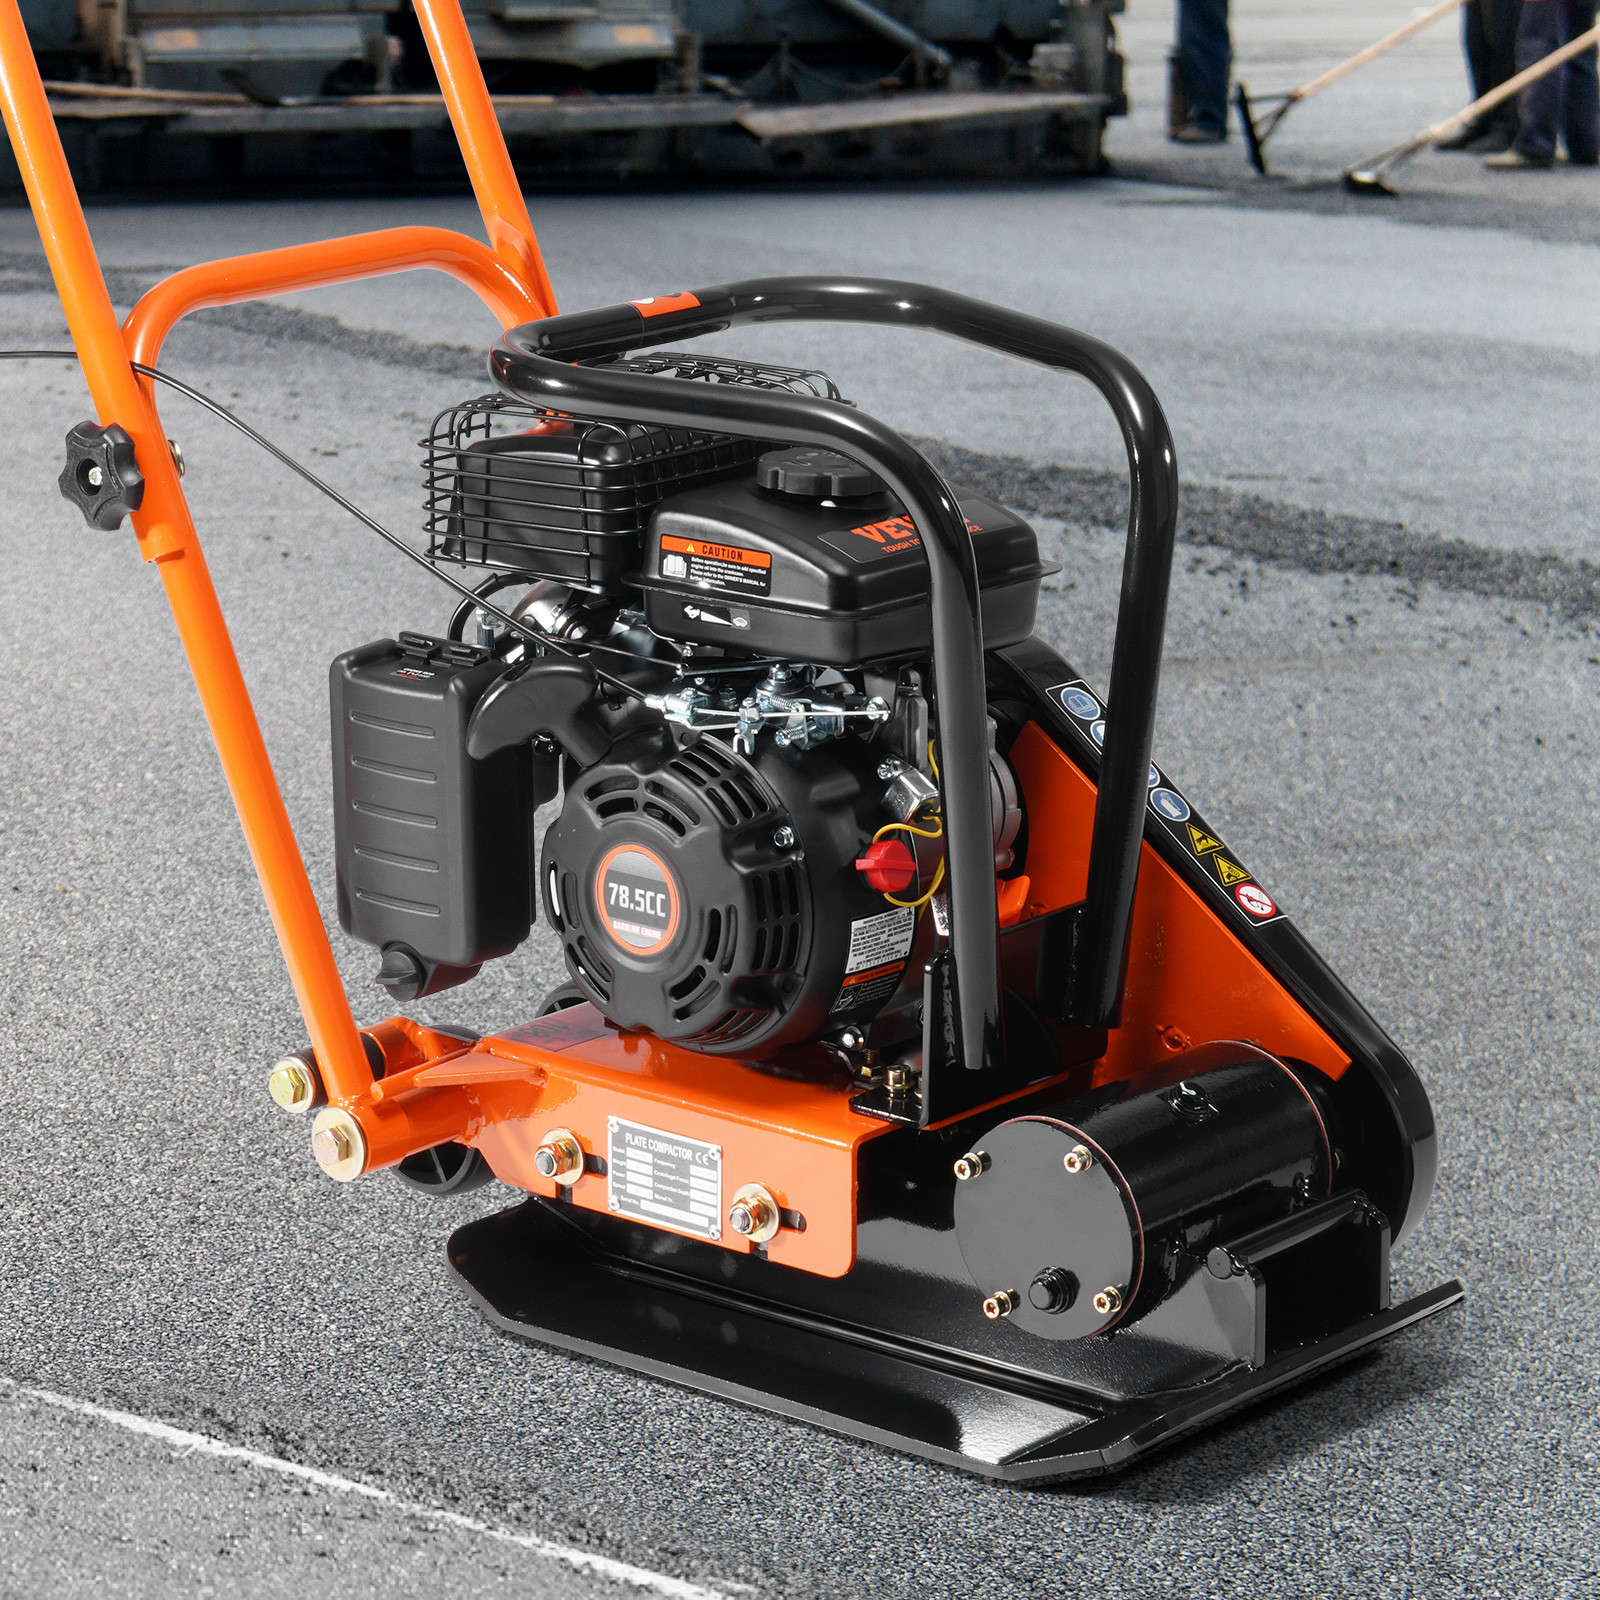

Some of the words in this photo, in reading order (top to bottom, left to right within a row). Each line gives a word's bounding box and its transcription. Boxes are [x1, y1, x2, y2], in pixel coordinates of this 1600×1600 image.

[702, 545, 743, 561] CAUTION
[881, 541, 912, 553] TOUGH
[691, 556, 704, 564] Before
[749, 567, 766, 575] specified
[724, 574, 743, 583] OWNER'S
[608, 882, 666, 917] 78.5CC
[613, 920, 640, 935] GASOLINE
[641, 926, 662, 940] ENGINE
[612, 1145, 626, 1154] Model
[625, 1132, 647, 1149] PLATE
[648, 1139, 693, 1161] COMPACTOR
[695, 1151, 709, 1166] CE
[654, 1157, 676, 1170] Frequency
[612, 1170, 626, 1178] Power
